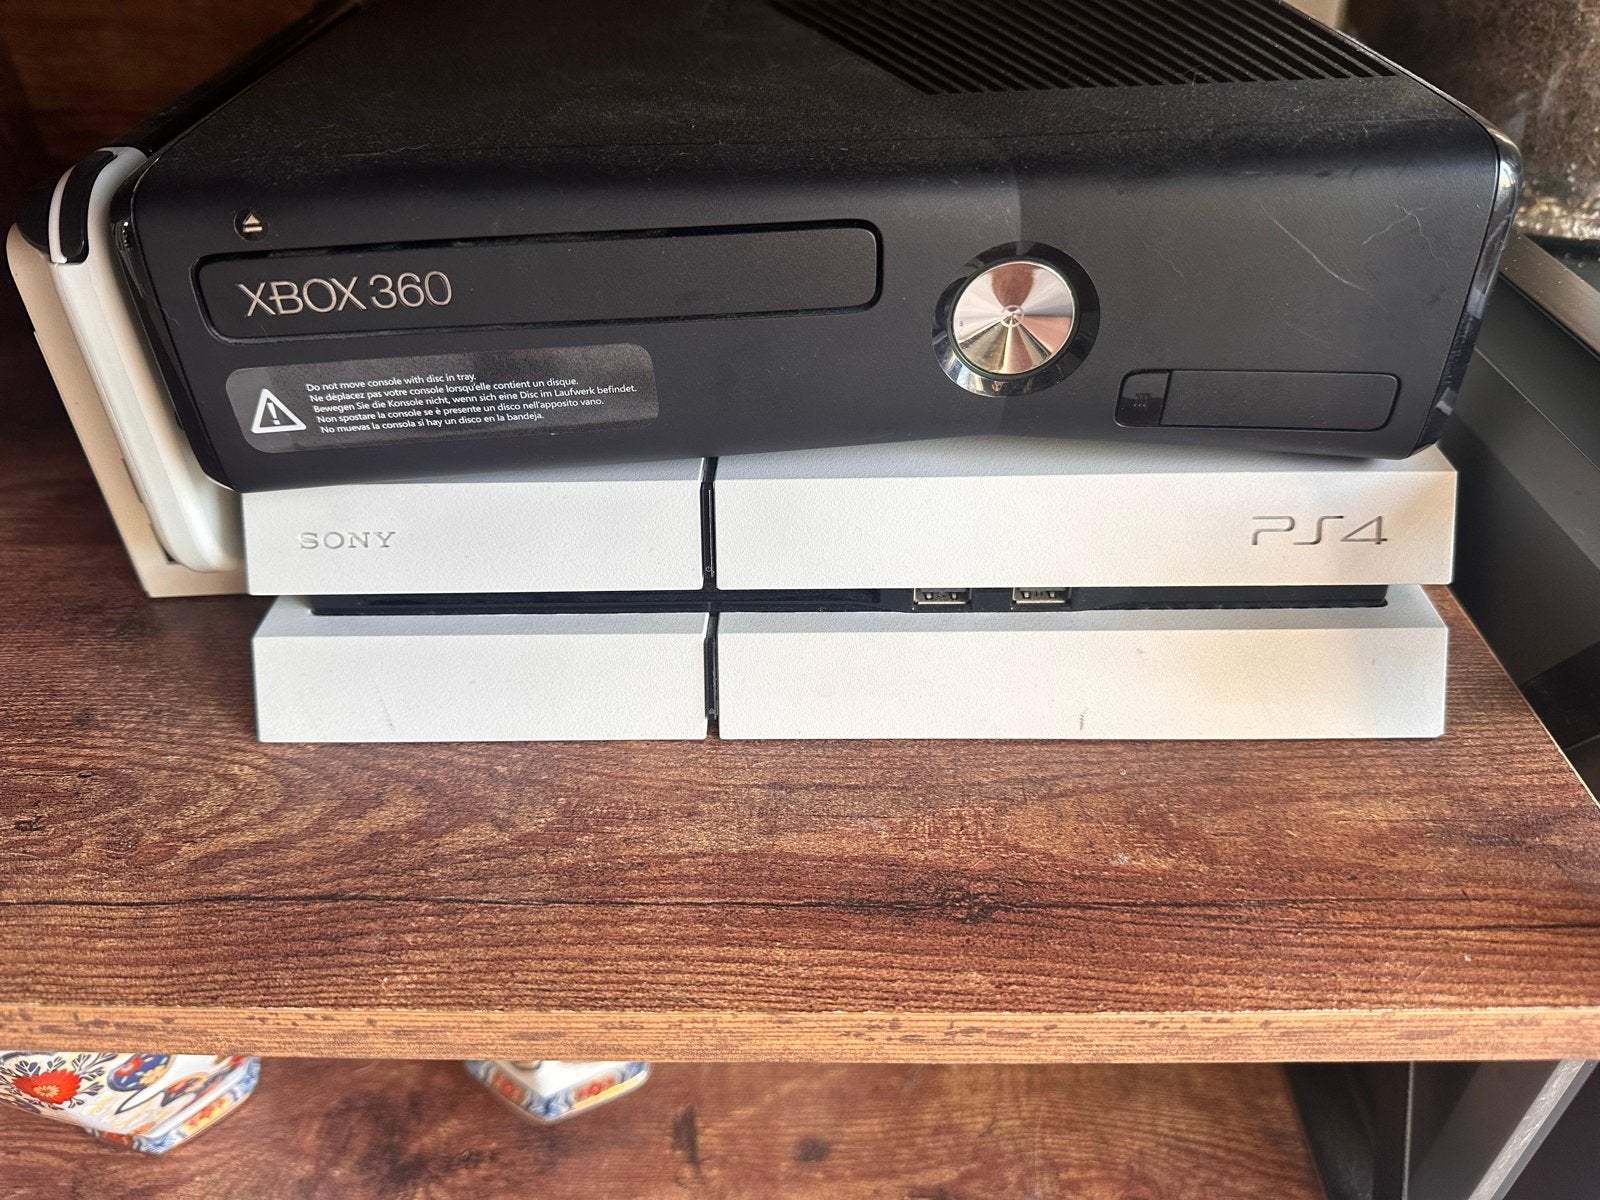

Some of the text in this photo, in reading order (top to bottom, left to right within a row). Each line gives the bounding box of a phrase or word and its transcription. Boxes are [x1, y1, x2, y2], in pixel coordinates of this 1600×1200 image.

[235, 270, 452, 318] XBOX 360
[306, 384, 320, 392] Do
[322, 382, 338, 390] not
[367, 377, 402, 387] console
[404, 376, 425, 385] with
[426, 374, 444, 383] disc
[445, 373, 455, 382] in
[457, 374, 476, 382] tray.
[325, 392, 365, 402] déplacez
[410, 386, 444, 395] console
[493, 380, 530, 390] contient
[546, 378, 578, 387] disque.
[314, 404, 355, 414] Bewegen
[388, 398, 424, 408] Konsole
[426, 397, 451, 405] nicht,
[452, 395, 478, 403] wenn
[480, 393, 497, 402] sich
[498, 392, 518, 400] eine
[554, 387, 595, 397] Laufwerk
[597, 385, 637, 394] befindet.
[337, 424, 371, 432] muevas
[382, 420, 416, 429] consola
[426, 418, 442, 428] hay
[458, 415, 482, 424] disco
[506, 412, 544, 421] bandeja.
[338, 412, 376, 423] spostare
[388, 409, 422, 418] console
[443, 406, 482, 416] presente
[497, 403, 520, 411] disco
[300, 531, 396, 550] SONY
[1251, 515, 1388, 546] PS4
